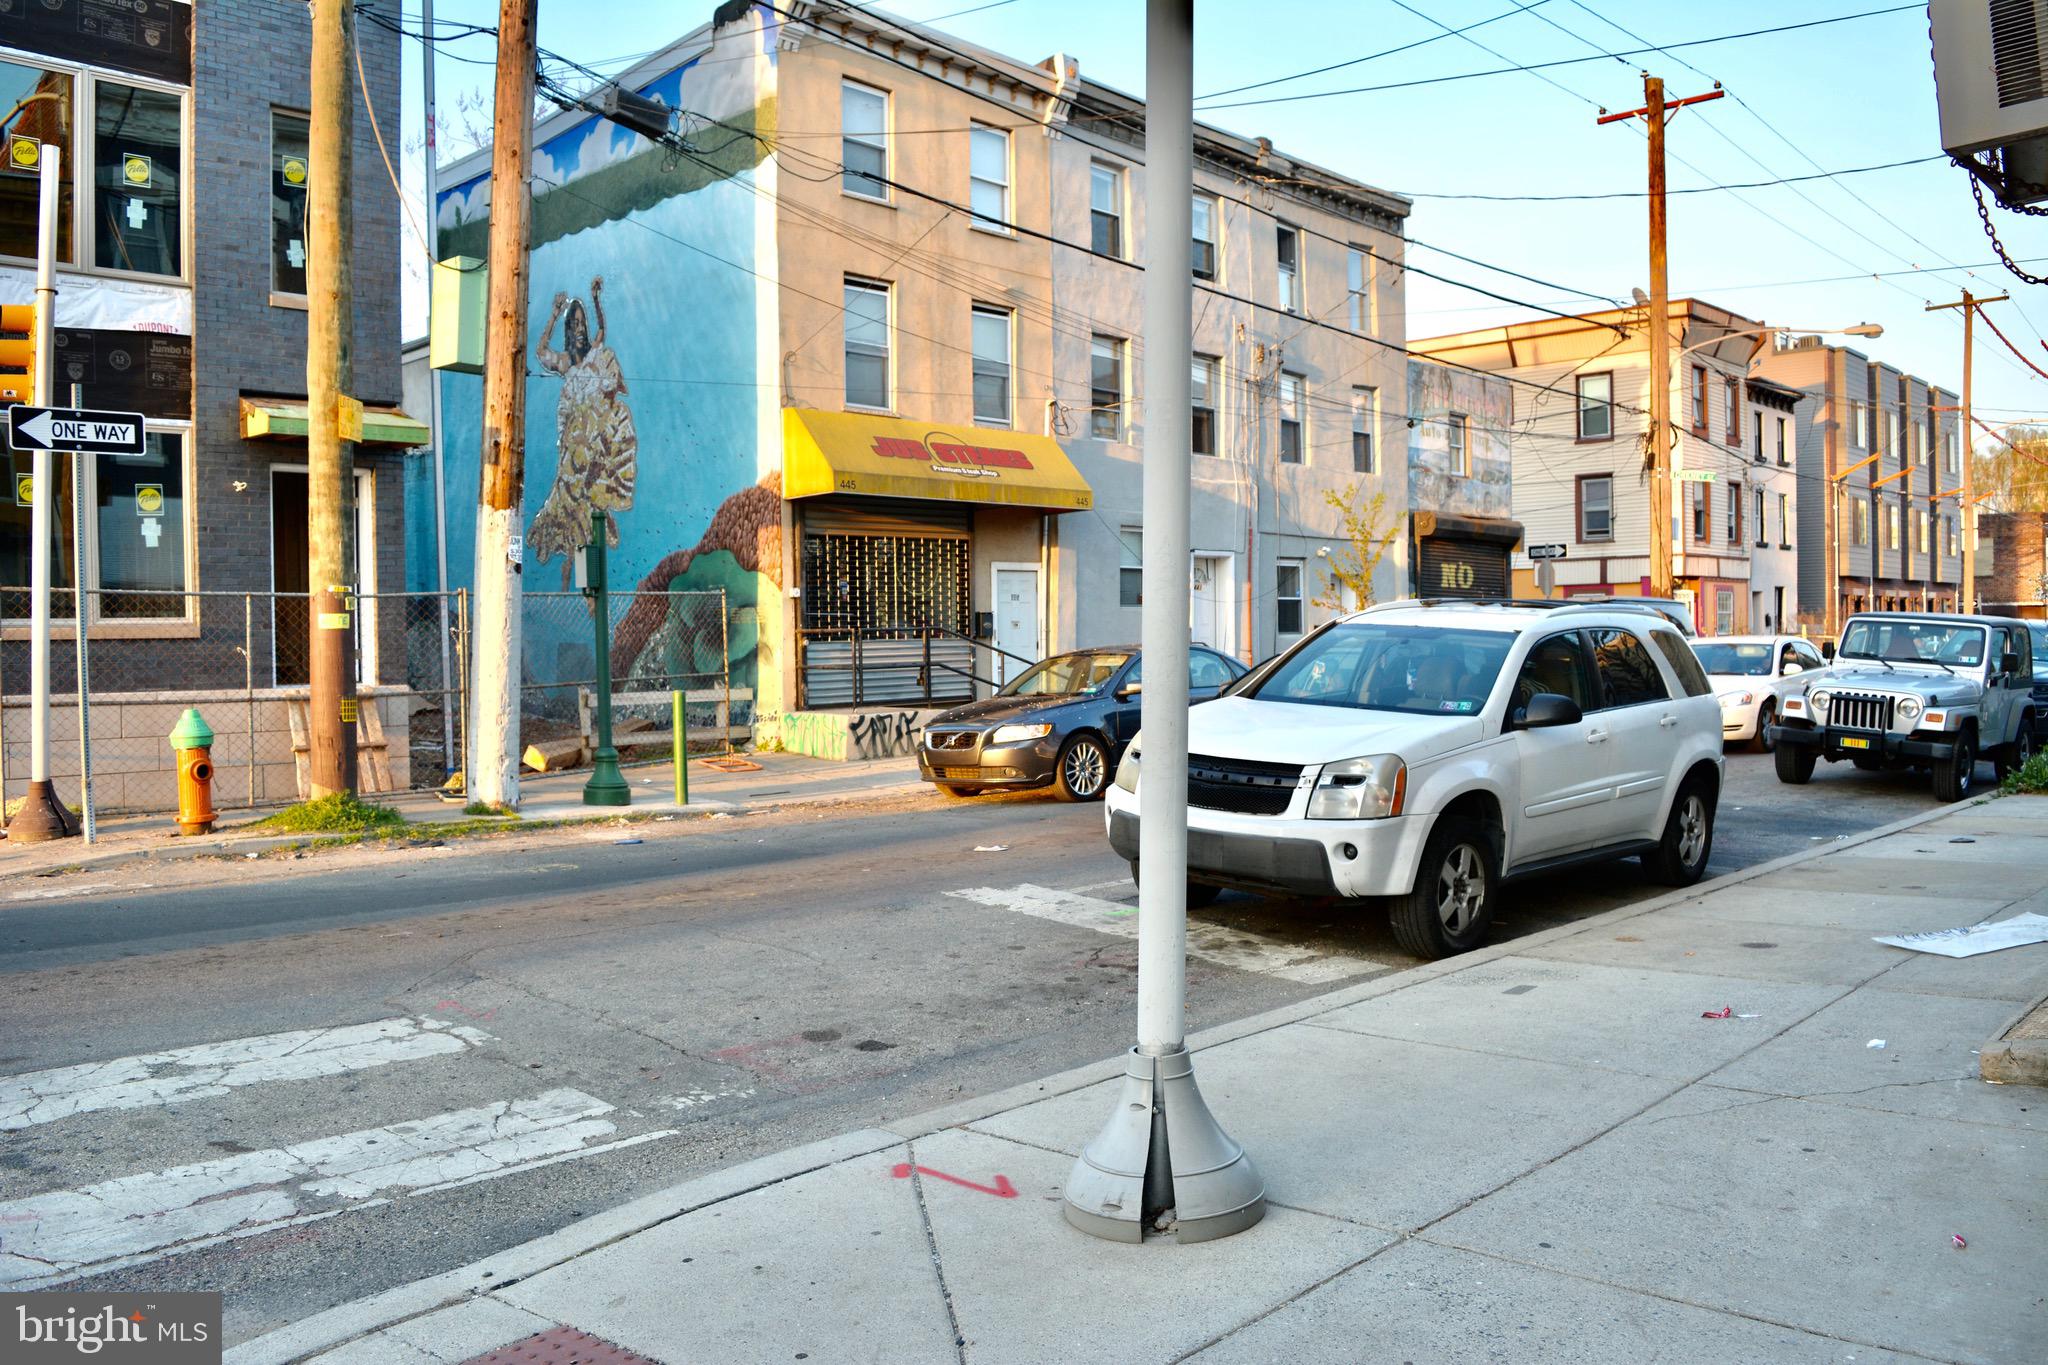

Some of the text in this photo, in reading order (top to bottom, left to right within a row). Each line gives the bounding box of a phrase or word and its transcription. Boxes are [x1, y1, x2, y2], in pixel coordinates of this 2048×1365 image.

[52, 421, 130, 441] ONE WAY
[840, 479, 857, 490] 445
[1076, 497, 1089, 507] 445
[1441, 561, 1475, 589] NO
